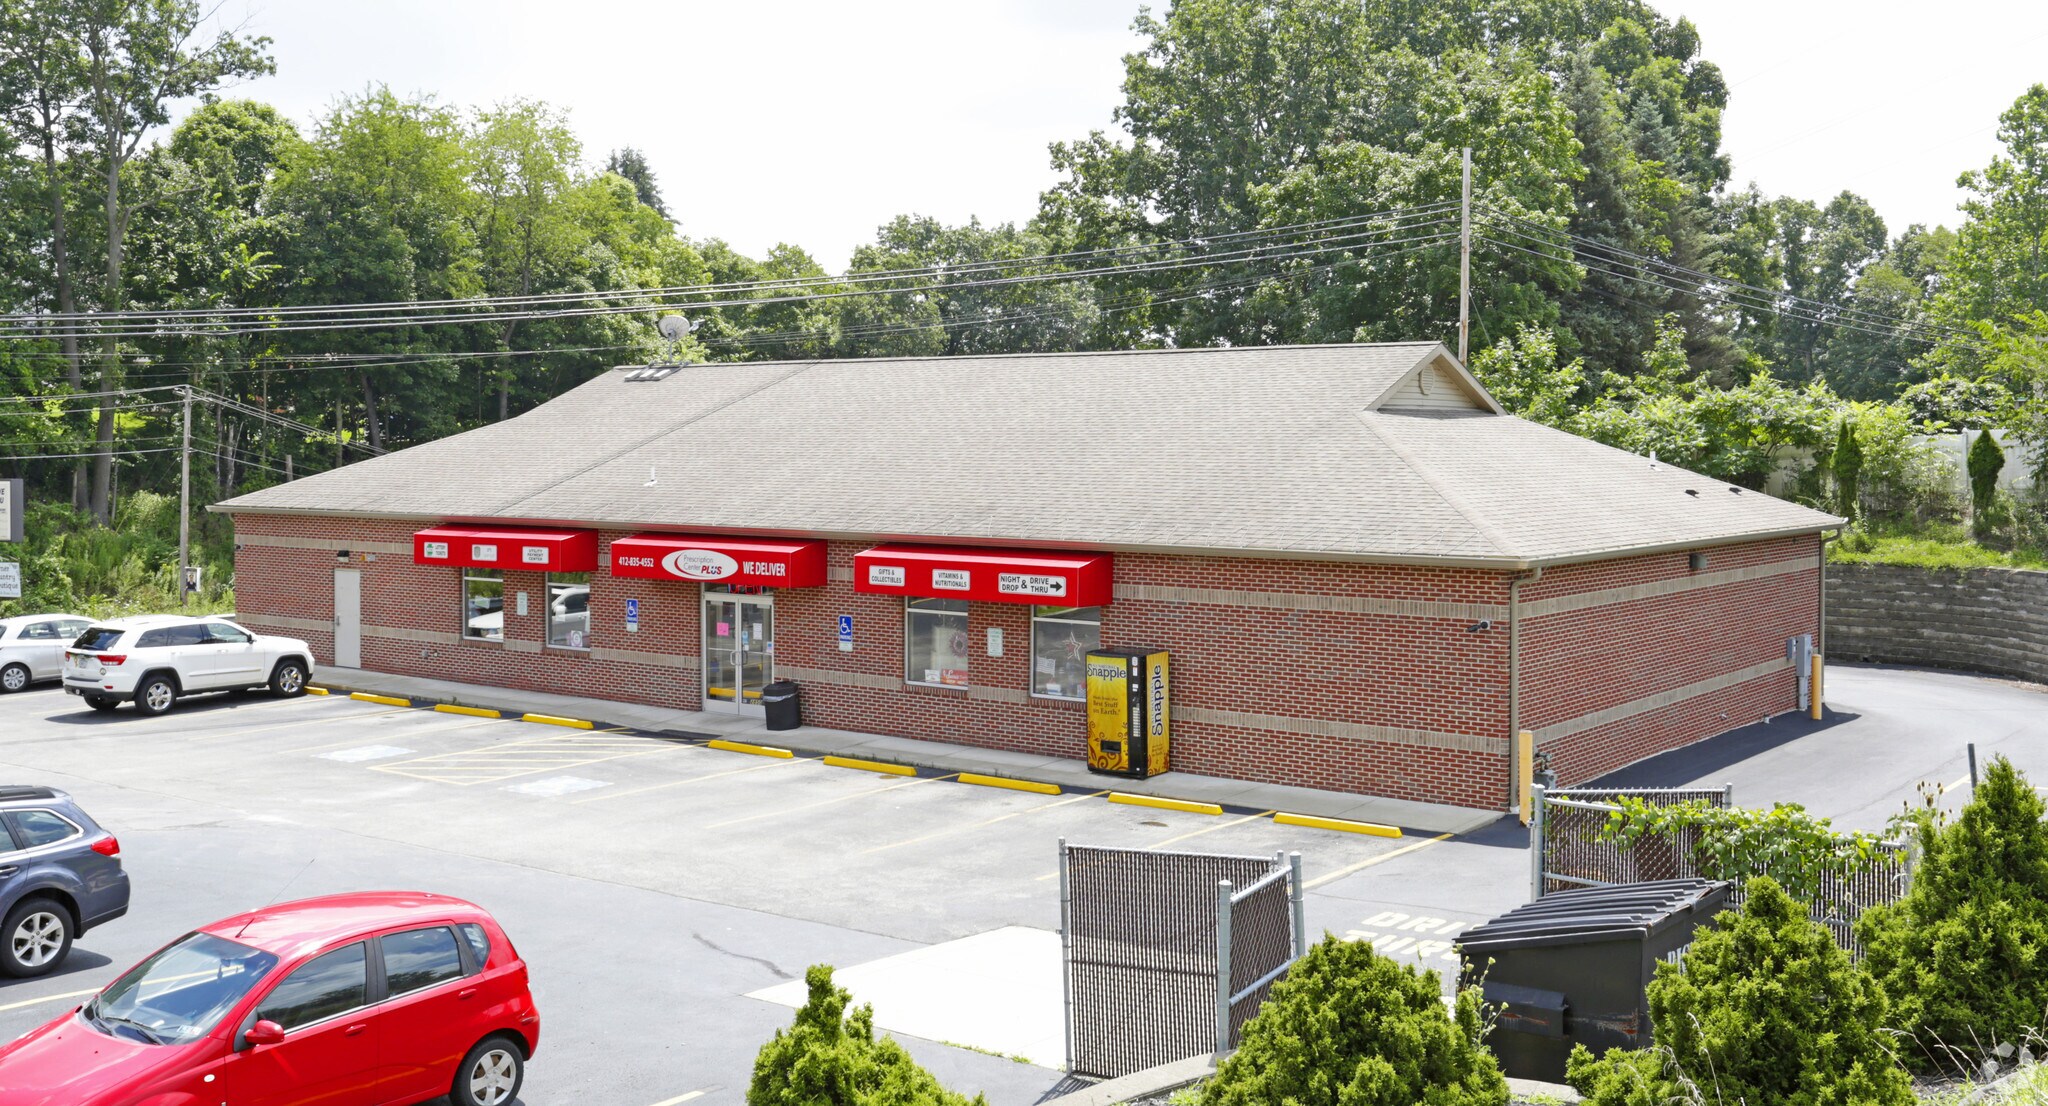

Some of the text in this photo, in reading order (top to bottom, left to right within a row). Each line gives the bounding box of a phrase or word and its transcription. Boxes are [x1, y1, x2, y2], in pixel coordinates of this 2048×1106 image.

[619, 556, 654, 567] 412-835-4552
[683, 555, 713, 563] Prescription
[683, 562, 722, 575] Center PLUS
[743, 561, 786, 577] WE DELIVER
[871, 575, 902, 584] COLLECTIBLES
[934, 580, 967, 588] NUTRITIONALS
[1021, 579, 1028, 589] &
[1030, 577, 1049, 585] DRIVE
[1087, 663, 1127, 681] Snapple
[1152, 664, 1164, 736] Snapple
[1361, 911, 1484, 935] DRI
